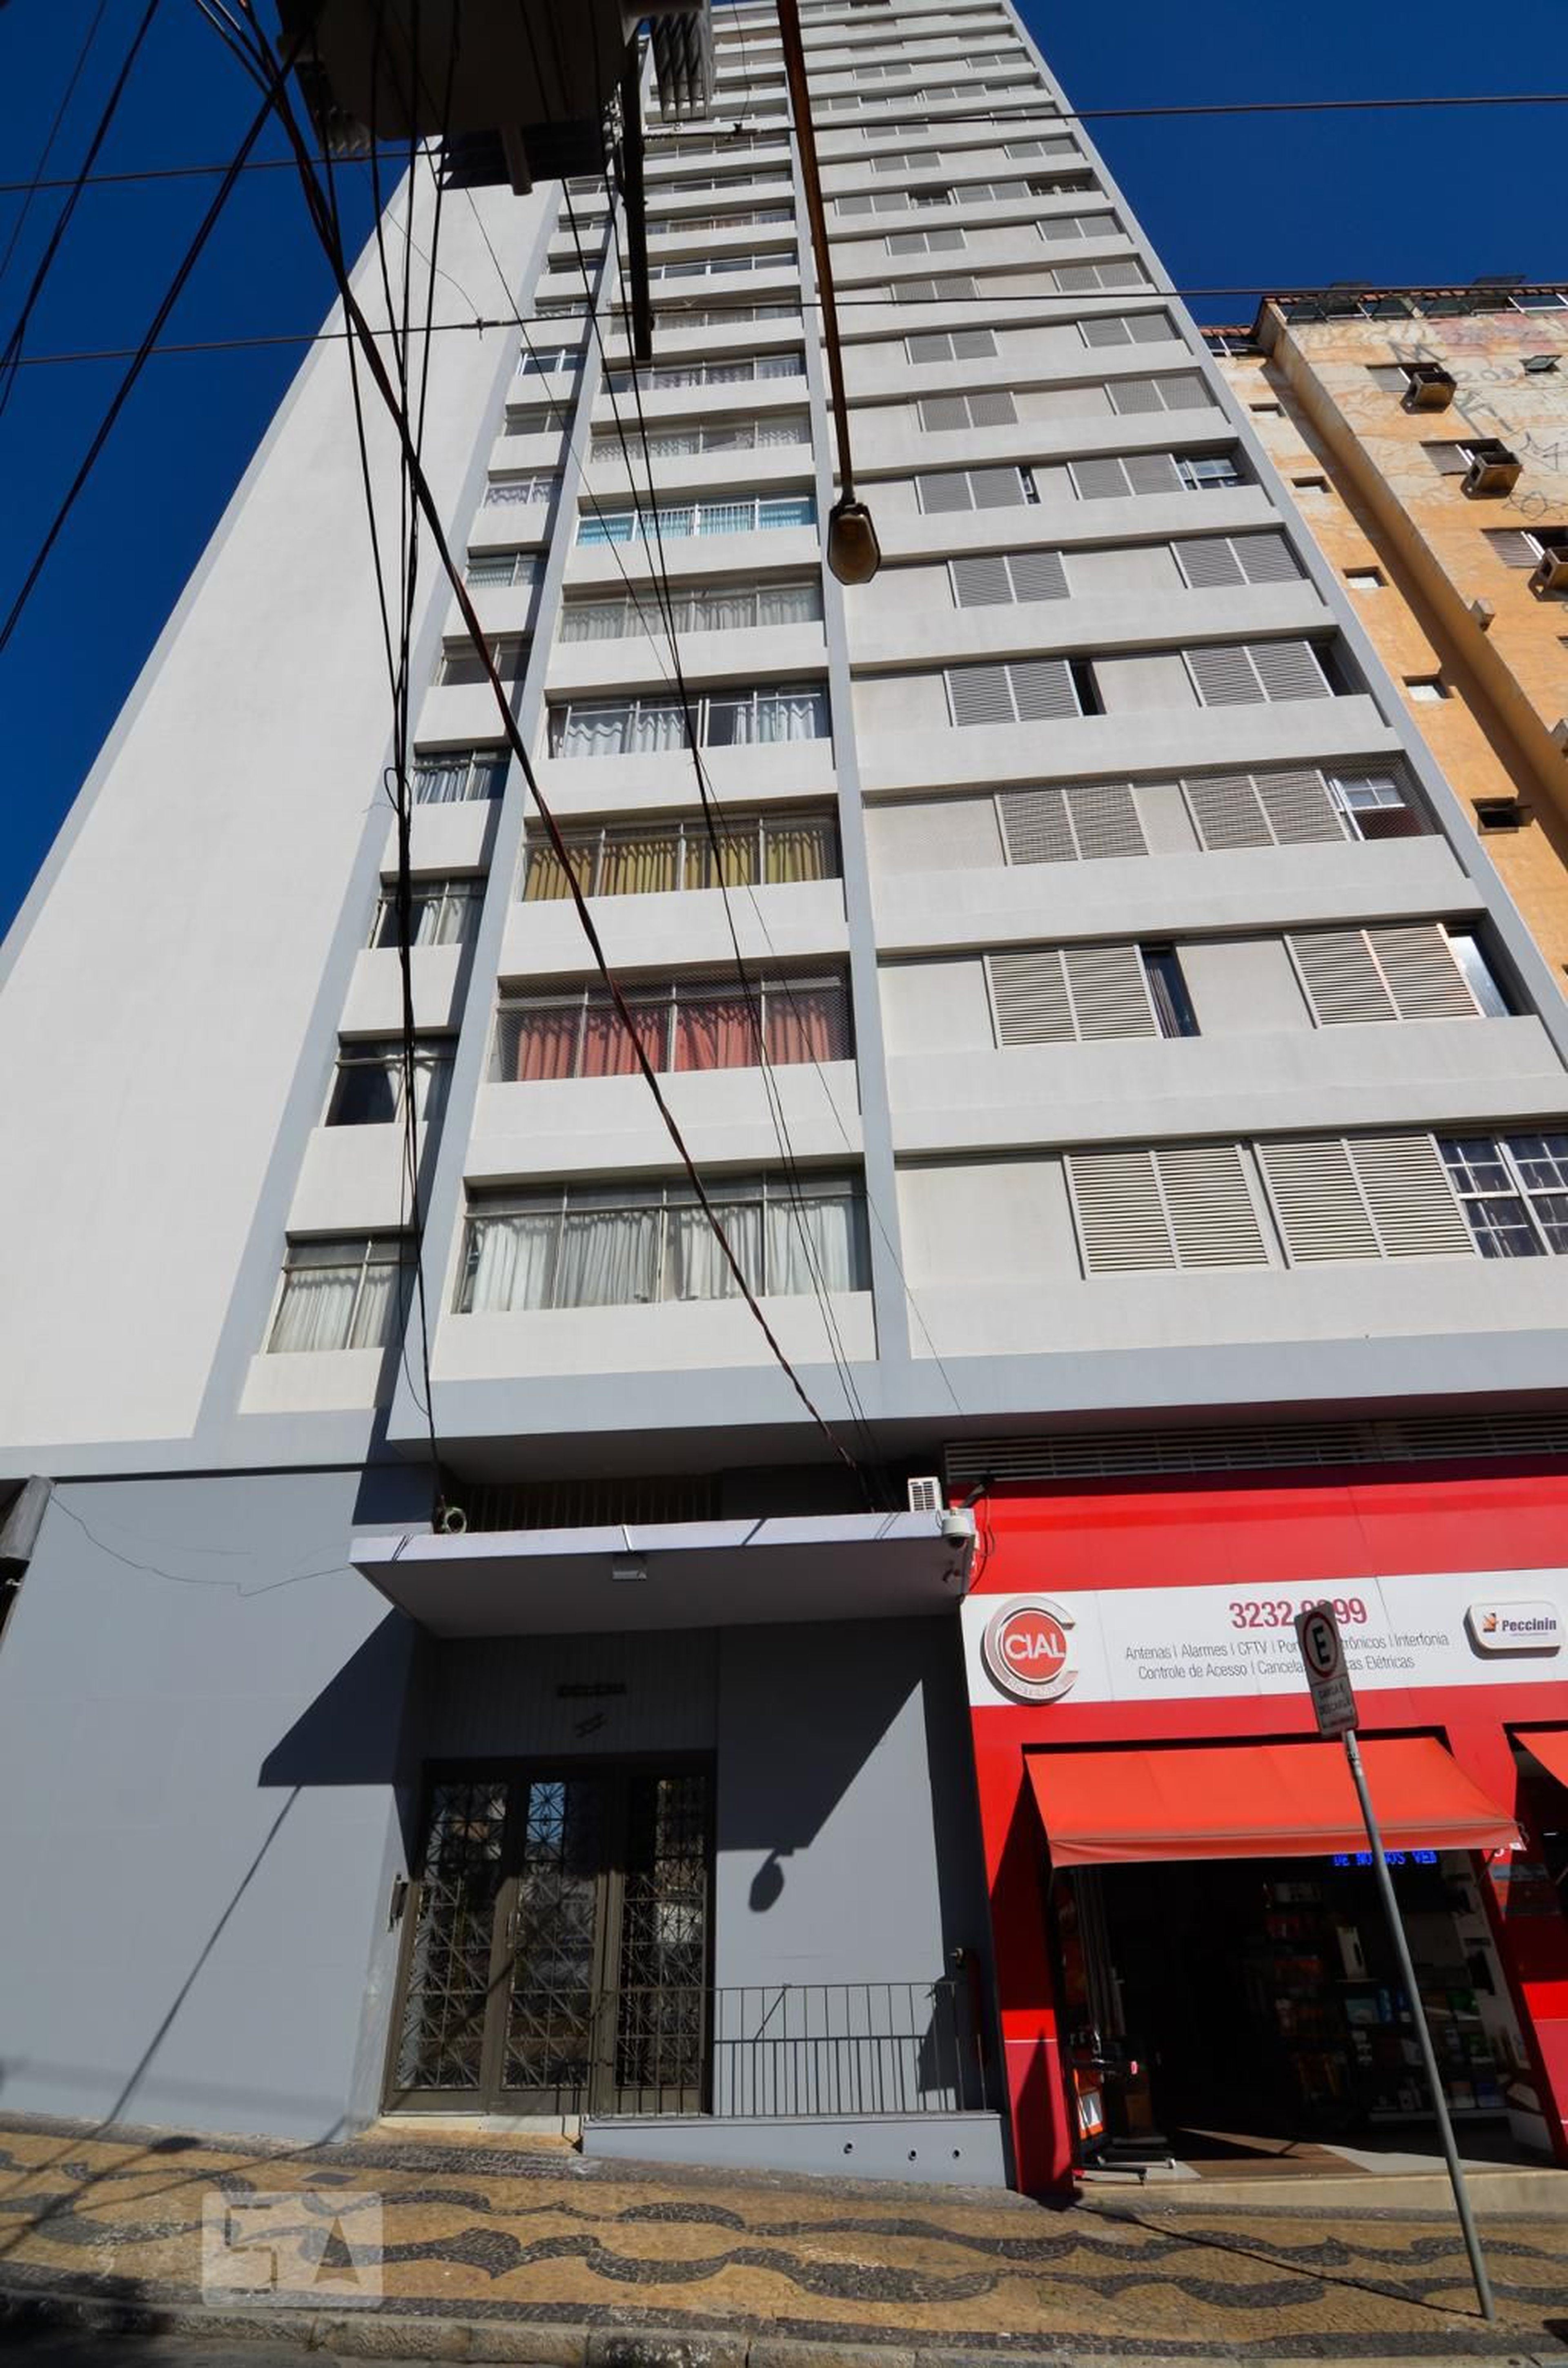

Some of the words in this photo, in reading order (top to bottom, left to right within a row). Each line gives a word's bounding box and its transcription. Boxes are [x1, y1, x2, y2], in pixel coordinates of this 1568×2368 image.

[1502, 1617, 1557, 1632] Peccinin
[1005, 1633, 1065, 1659] CIAL
[1126, 1646, 1172, 1659] Antenas
[1182, 1643, 1228, 1657] Alarmes
[1237, 1640, 1267, 1656] CFTV
[1312, 1625, 1331, 1665] E
[1139, 1664, 1185, 1679] Controle
[1189, 1663, 1202, 1678] de
[1206, 1662, 1247, 1677] Acesso
[1365, 1654, 1415, 1670] Elétricas
